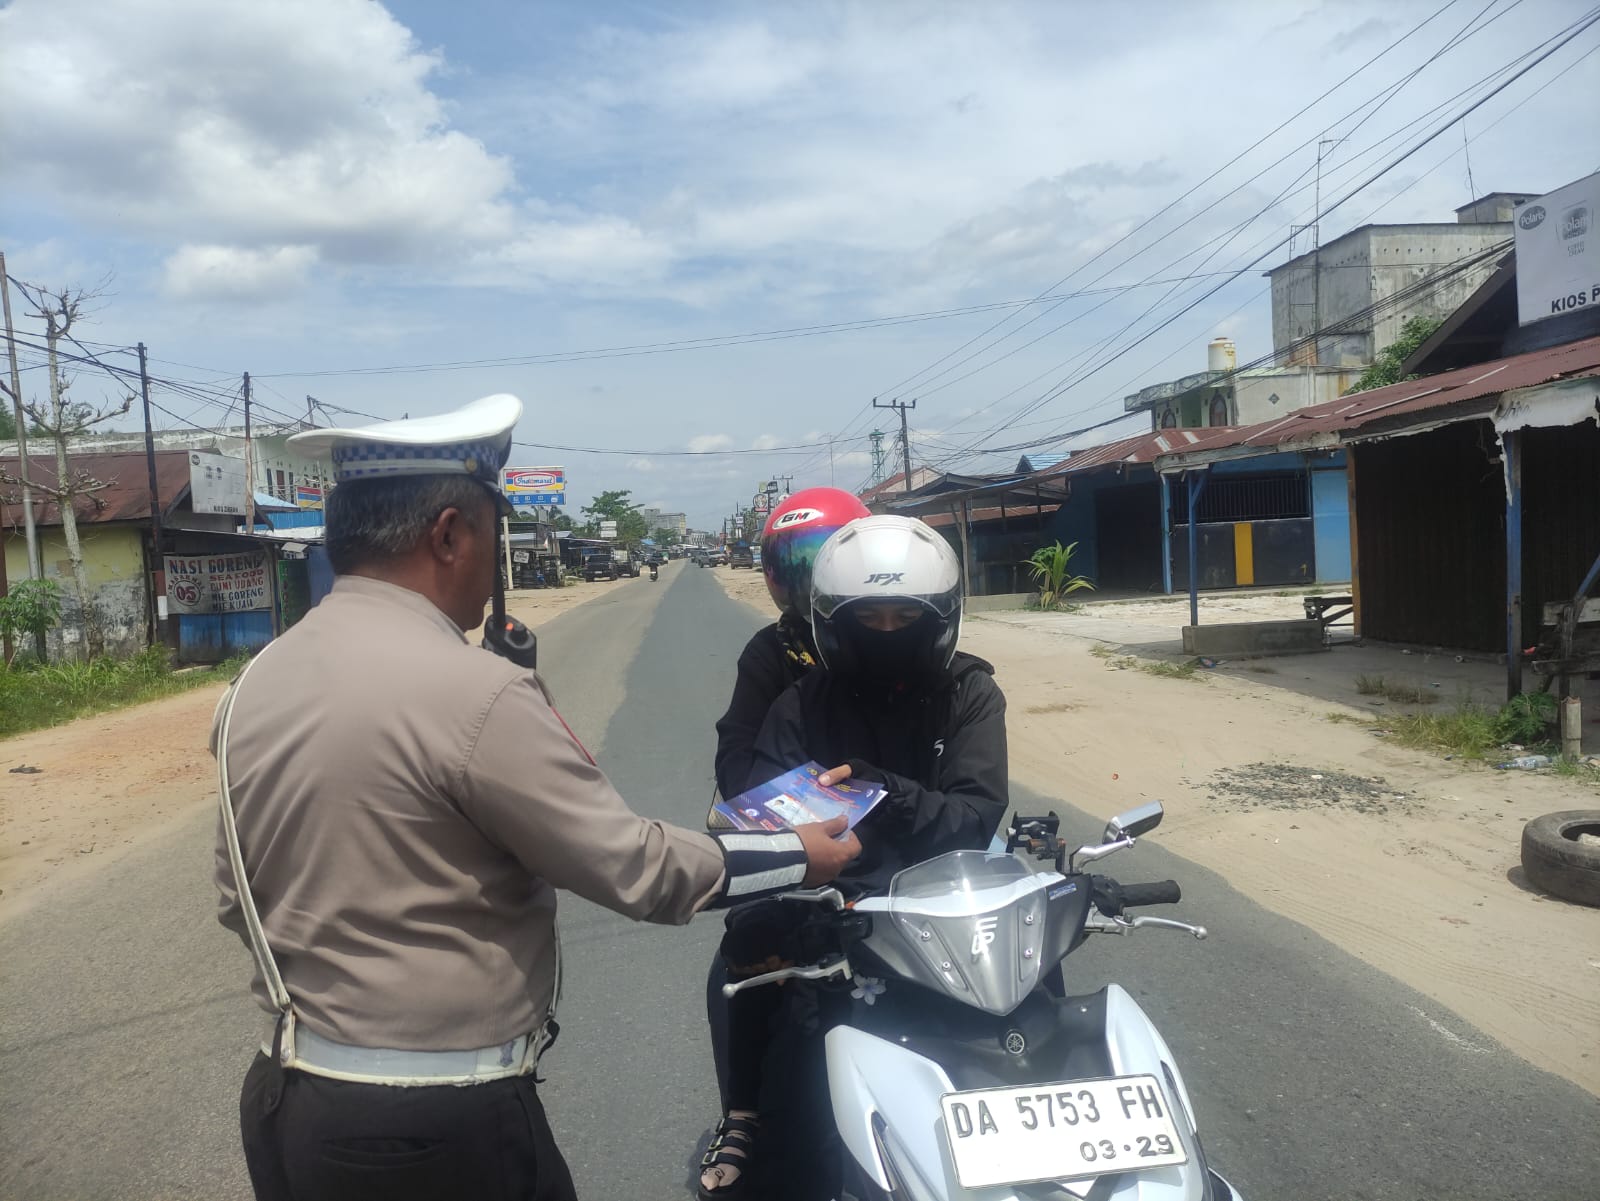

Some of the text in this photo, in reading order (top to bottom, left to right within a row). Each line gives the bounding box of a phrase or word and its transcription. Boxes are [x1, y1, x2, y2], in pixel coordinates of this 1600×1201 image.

[1520, 210, 1545, 227] Polaris
[1551, 291, 1587, 313] KIOS
[781, 511, 810, 523] GM
[169, 554, 265, 574] NASI GORENG
[210, 576, 264, 592] CUMI UDANG
[863, 572, 905, 586] JPX
[175, 585, 197, 601] 05
[228, 587, 264, 602] GORENG
[951, 1084, 1164, 1138] DA 5753 FH
